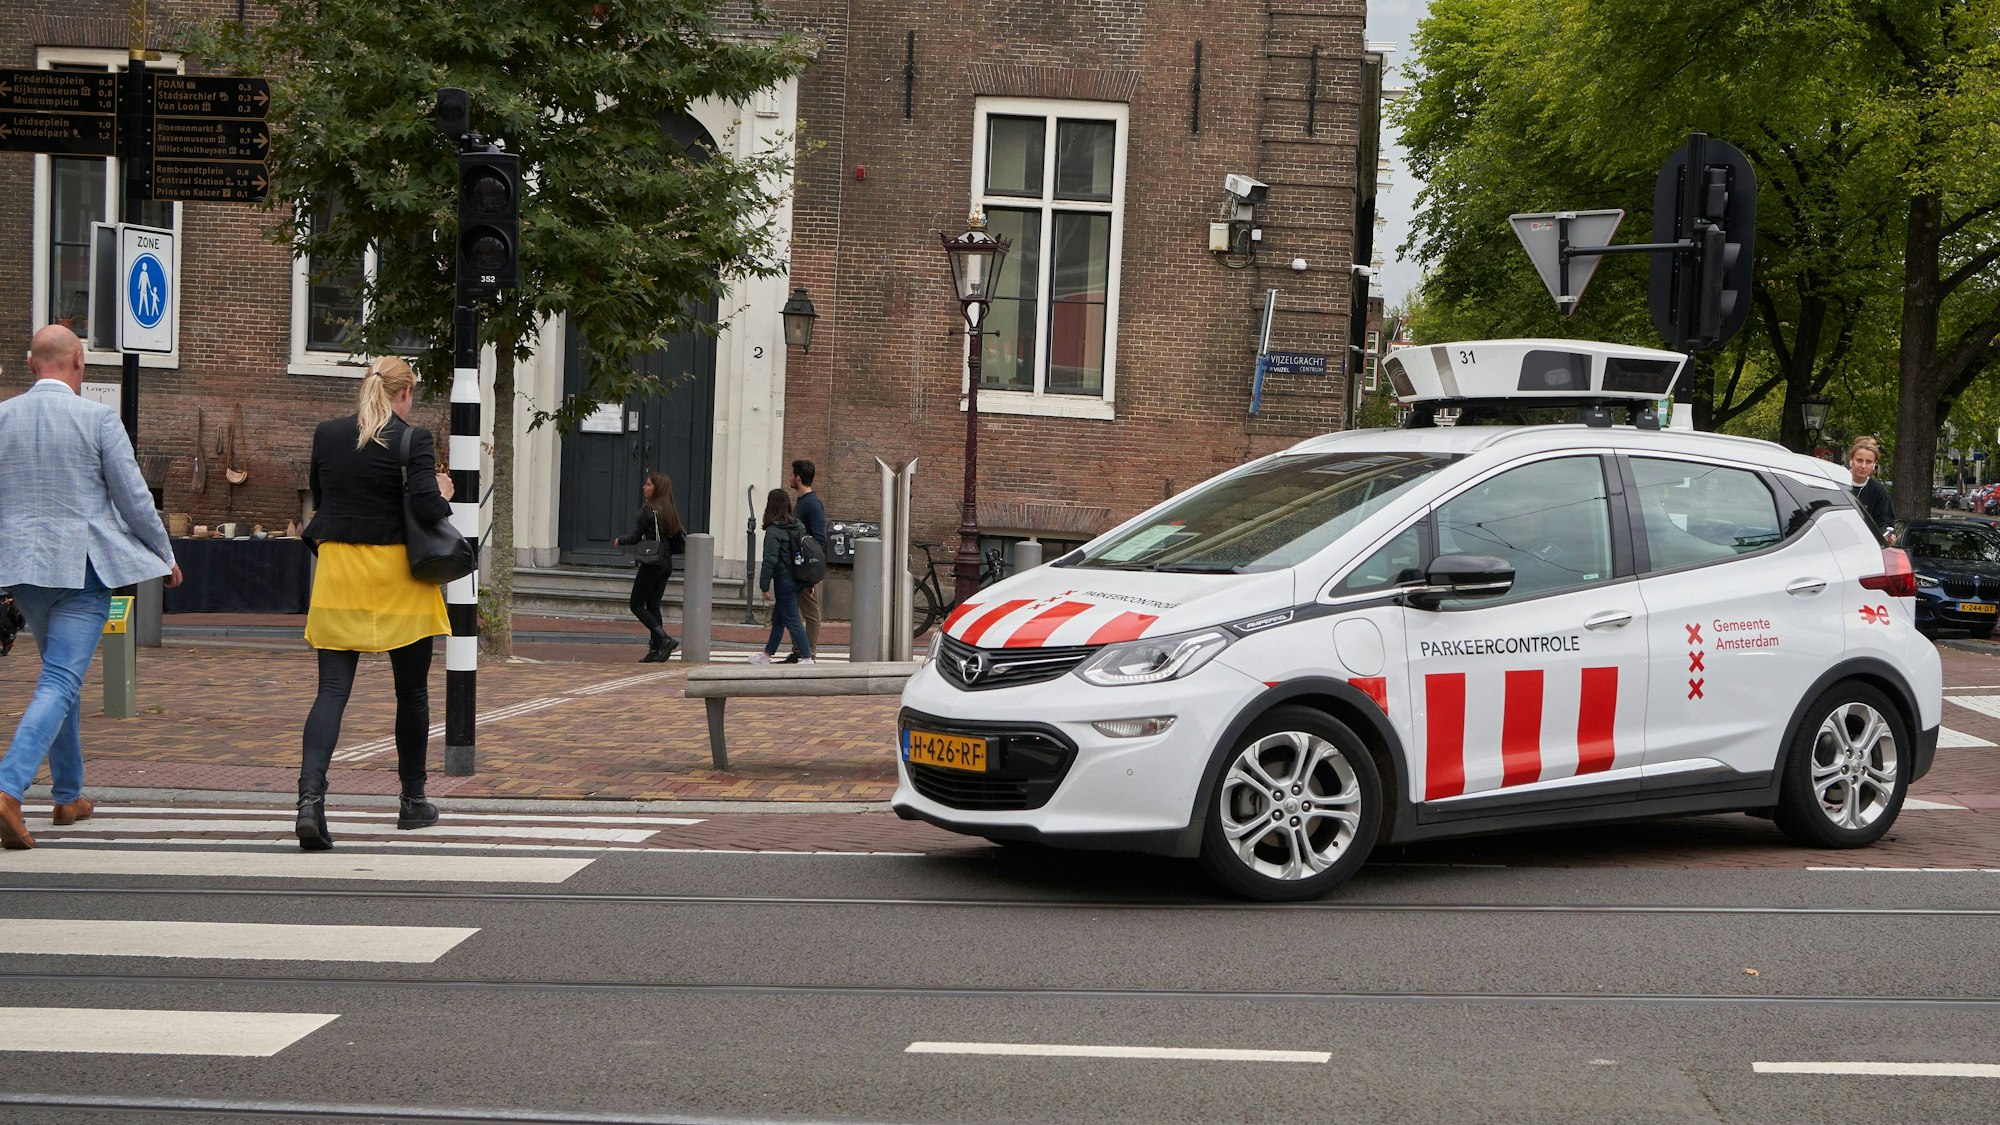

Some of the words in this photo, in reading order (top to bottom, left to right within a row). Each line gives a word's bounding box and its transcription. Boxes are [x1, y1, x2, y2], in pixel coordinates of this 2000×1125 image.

[14, 74, 85, 86] Frederiksplein
[99, 79, 113, 87] 0,8
[158, 80, 185, 89] FOAM
[14, 85, 78, 96] Rijksmuseum
[99, 89, 113, 97] 0,8
[158, 91, 217, 101] Stadsarchief
[14, 96, 79, 107] Museumplein
[99, 100, 111, 108] 1,0
[158, 102, 175, 110] Van
[178, 102, 200, 111] Loon
[238, 105, 251, 113] 0,3
[14, 117, 69, 128] Leidseplein
[99, 121, 111, 129] 1,0
[157, 124, 214, 132] Bloemenmarkt
[14, 128, 69, 138] Vondelpark
[157, 135, 216, 143] Tassenmuseum
[157, 145, 227, 155] Willet-Holthuysen
[157, 165, 224, 176] Rembrandtplein
[156, 176, 191, 185] Centraal
[193, 177, 224, 186] Station
[157, 187, 178, 196] Prins
[193, 187, 220, 197] Keizer
[137, 236, 160, 250] ZONE
[480, 275, 496, 283] 352
[753, 346, 764, 359] 2
[1459, 350, 1476, 364] 31
[1271, 355, 1325, 366] VIJZELGRACHT
[1082, 590, 1183, 609] PARKEERCONTROLE
[1713, 618, 1771, 632] Gemeente
[1420, 636, 1580, 657] PARKEERCONTROLE
[1716, 634, 1779, 650] Amsterdam
[913, 735, 983, 767] H-426-RF
